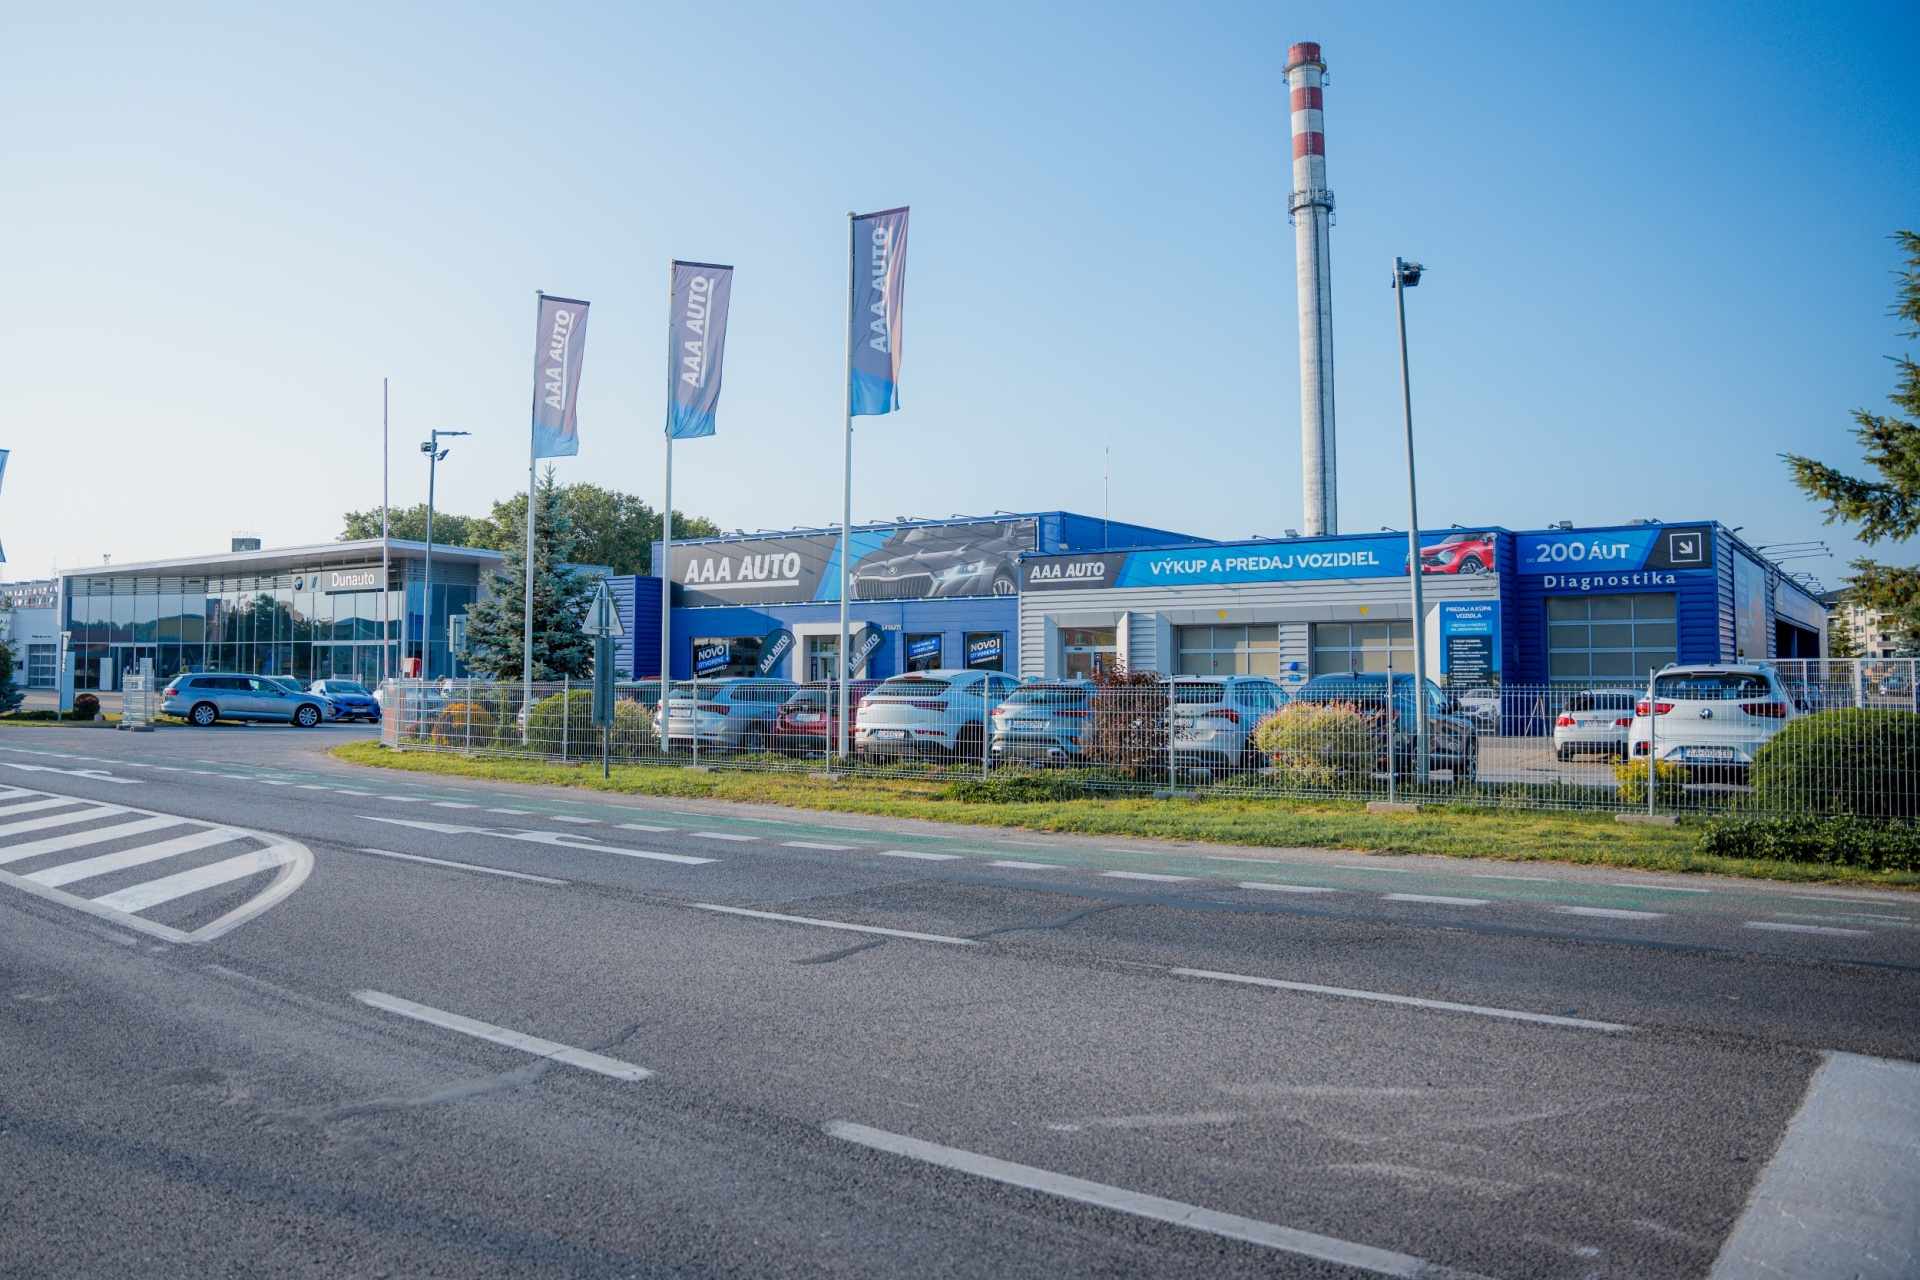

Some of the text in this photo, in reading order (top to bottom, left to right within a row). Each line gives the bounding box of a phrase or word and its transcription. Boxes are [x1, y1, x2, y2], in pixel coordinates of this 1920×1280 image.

[870, 227, 889, 352] AAA AUTO
[682, 276, 708, 387] AAA AUTO
[545, 310, 570, 409] AAA AUTO
[1150, 551, 1380, 576] VÝKUP A PREDAJ VOZIDIEL
[1536, 541, 1585, 563] 200
[1588, 540, 1631, 560] ÁUT
[332, 572, 375, 587] Dunauto
[685, 552, 801, 583] AAA AUTO
[1030, 562, 1105, 579] AAA AUTO
[1543, 572, 1677, 590] Diagnostika
[761, 635, 788, 672] AAA AUTO
[848, 633, 878, 671] AAA AUTO
